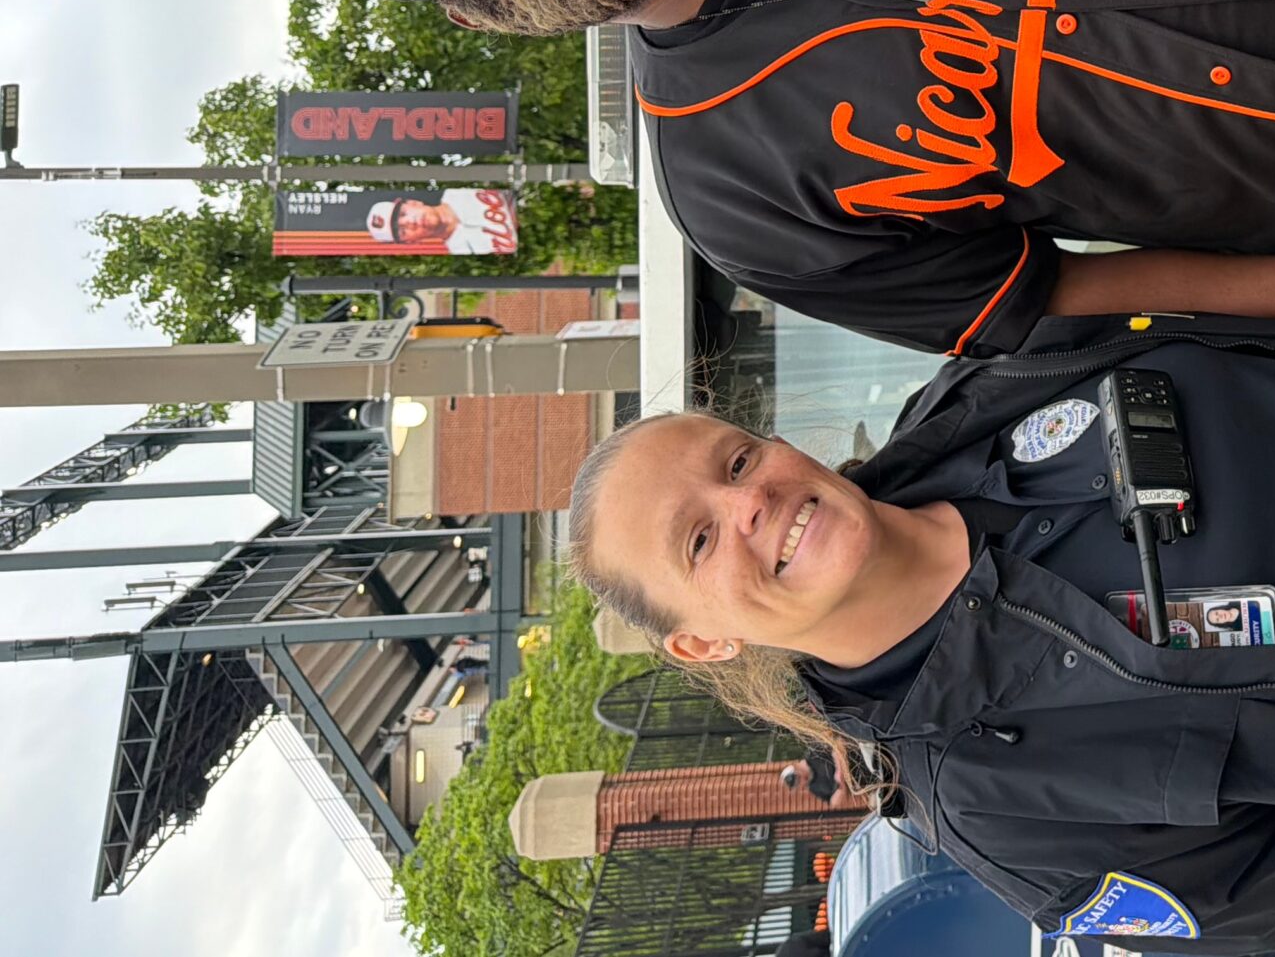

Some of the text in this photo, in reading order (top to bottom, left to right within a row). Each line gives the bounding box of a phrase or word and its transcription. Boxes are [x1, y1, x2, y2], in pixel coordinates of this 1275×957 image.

[291, 107, 506, 141] BIRDLAND
[287, 330, 321, 350] NO
[320, 324, 362, 354] TURN
[353, 323, 397, 359] ON RE
[1083, 881, 1127, 923] SAFETY
